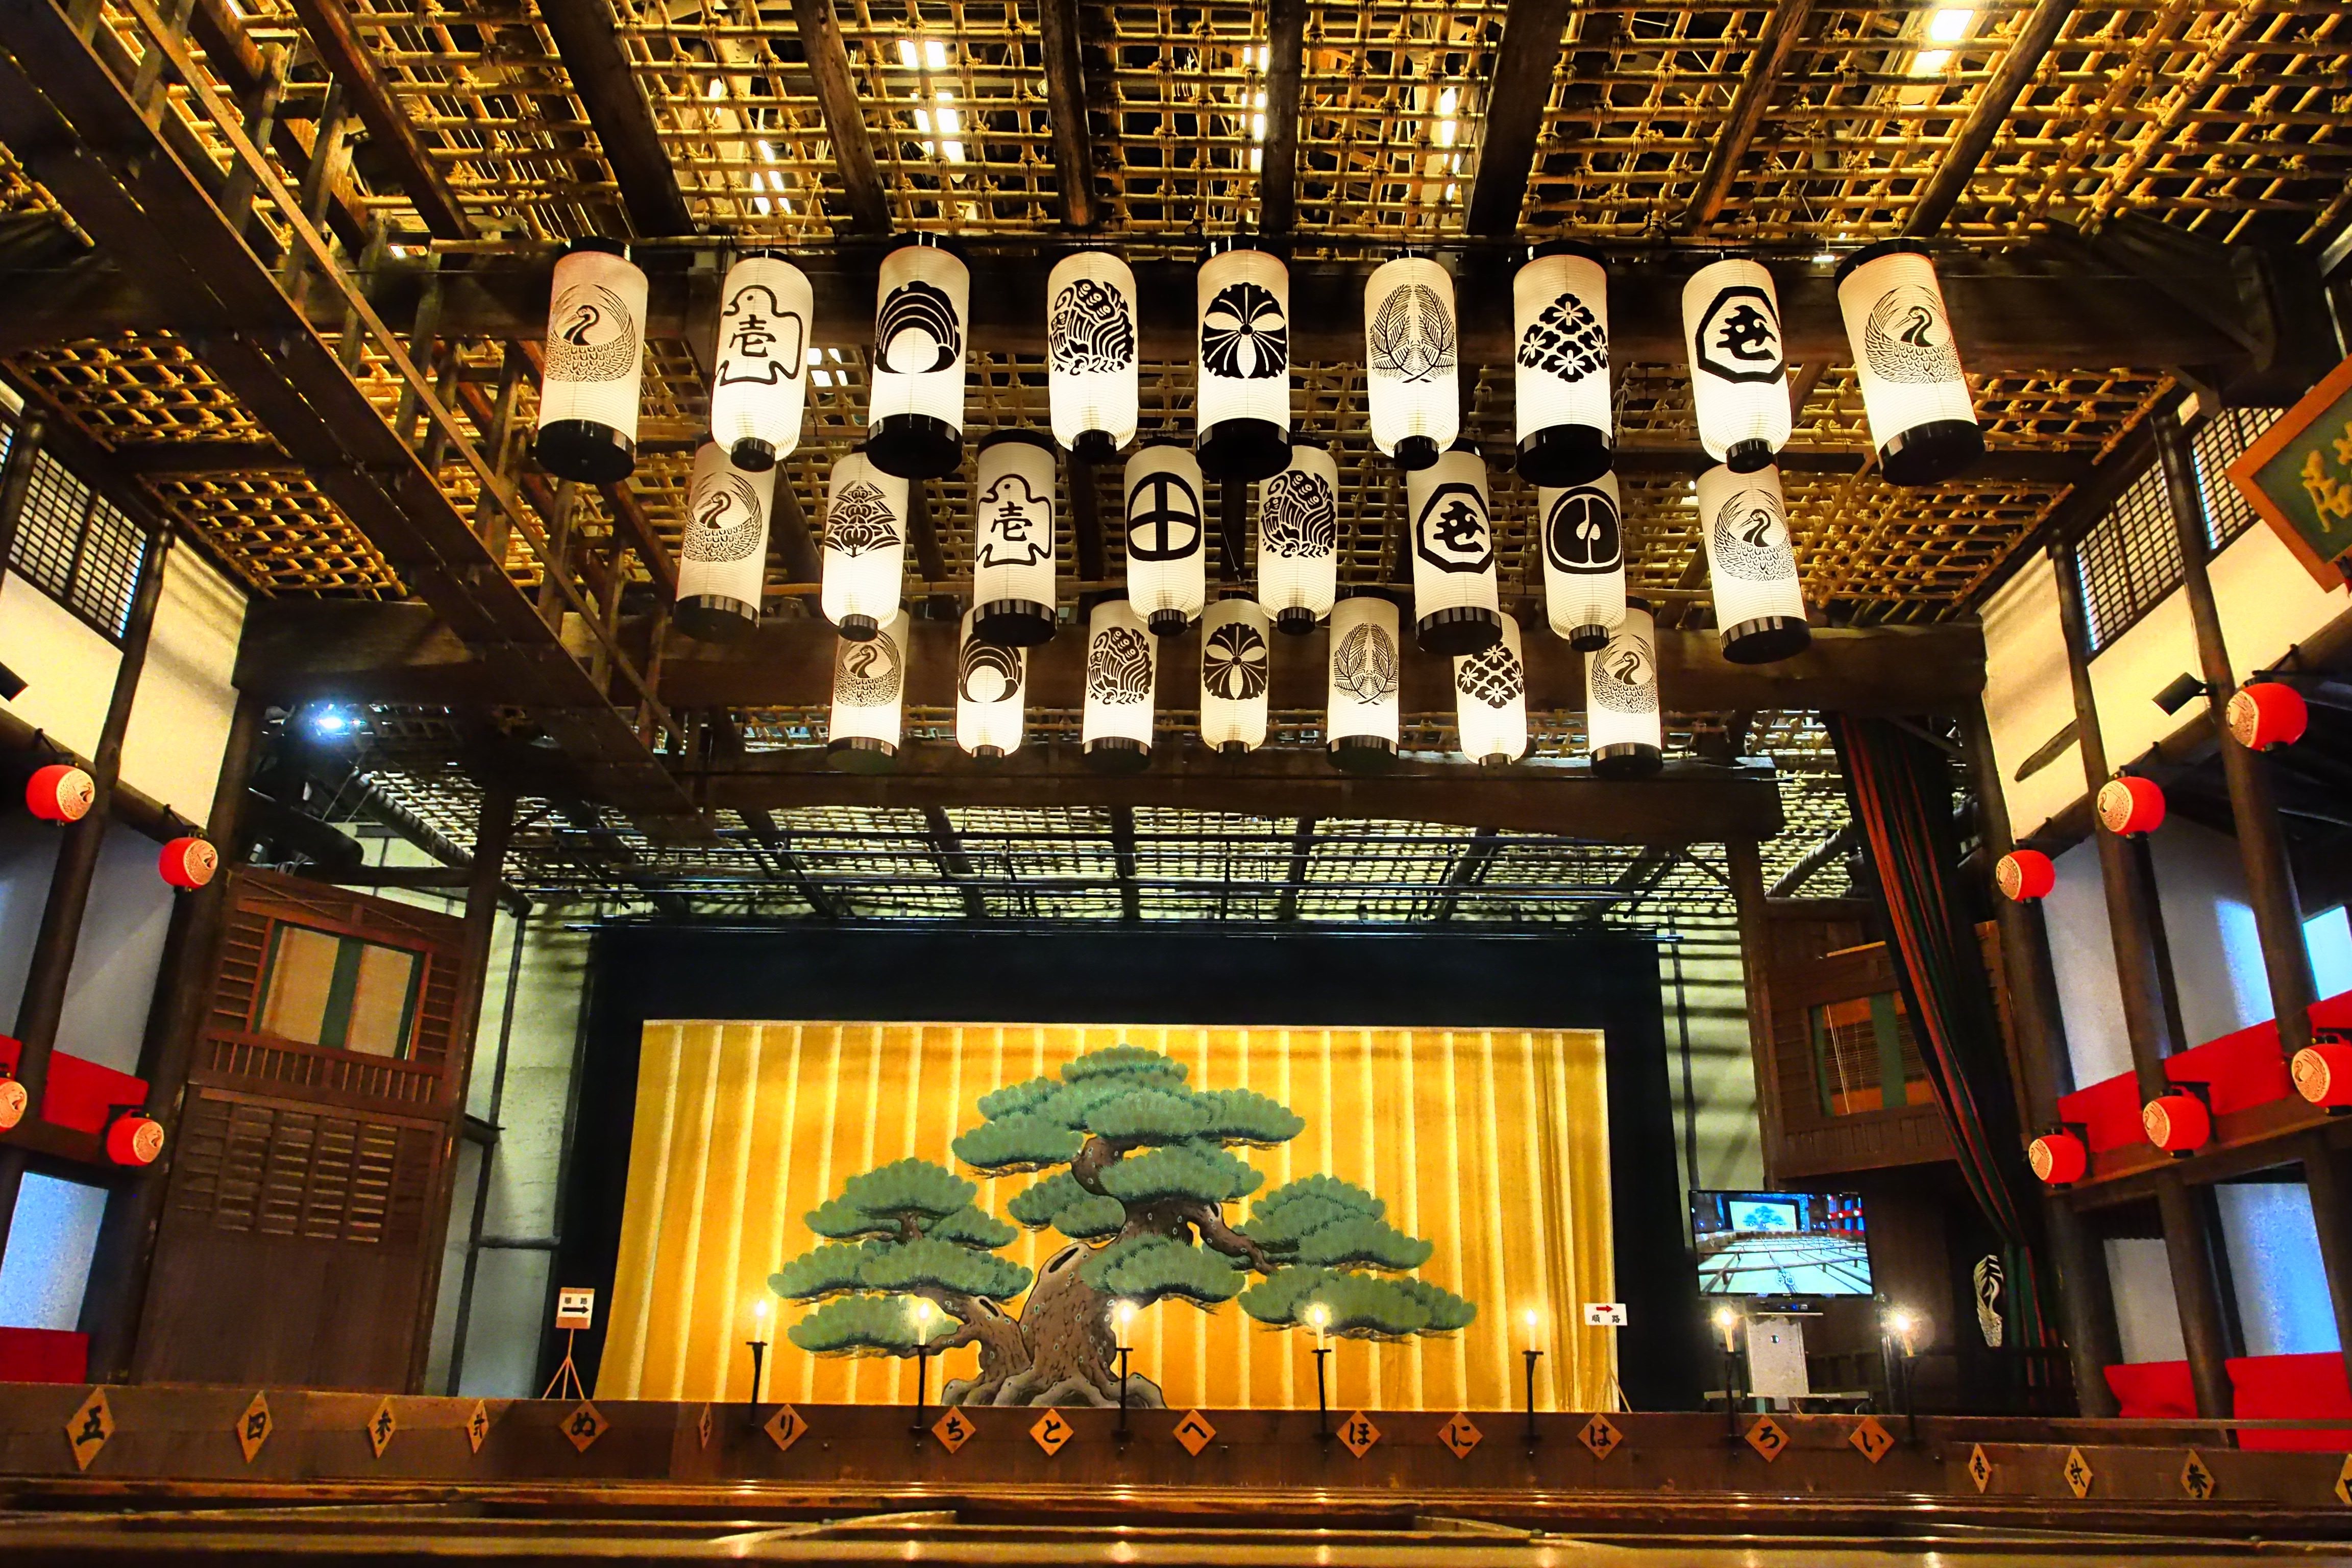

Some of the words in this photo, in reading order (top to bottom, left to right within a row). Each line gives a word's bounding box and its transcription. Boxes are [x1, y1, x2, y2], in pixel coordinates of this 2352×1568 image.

[729, 313, 776, 358] 壱
[991, 502, 1033, 542] 壱
[1591, 1314, 1621, 1324] 順路
[77, 1405, 105, 1446] 五
[248, 1412, 266, 1439] 四
[571, 1412, 596, 1437] ぬ
[780, 1415, 794, 1440] り
[946, 1416, 964, 1441] ち
[1044, 1419, 1061, 1443] と
[1182, 1423, 1207, 1438] へ
[1349, 1422, 1371, 1446] ほ
[1451, 1424, 1473, 1447] に
[1590, 1425, 1611, 1447] は
[1759, 1426, 1780, 1449] ろ
[1861, 1431, 1884, 1453] い
